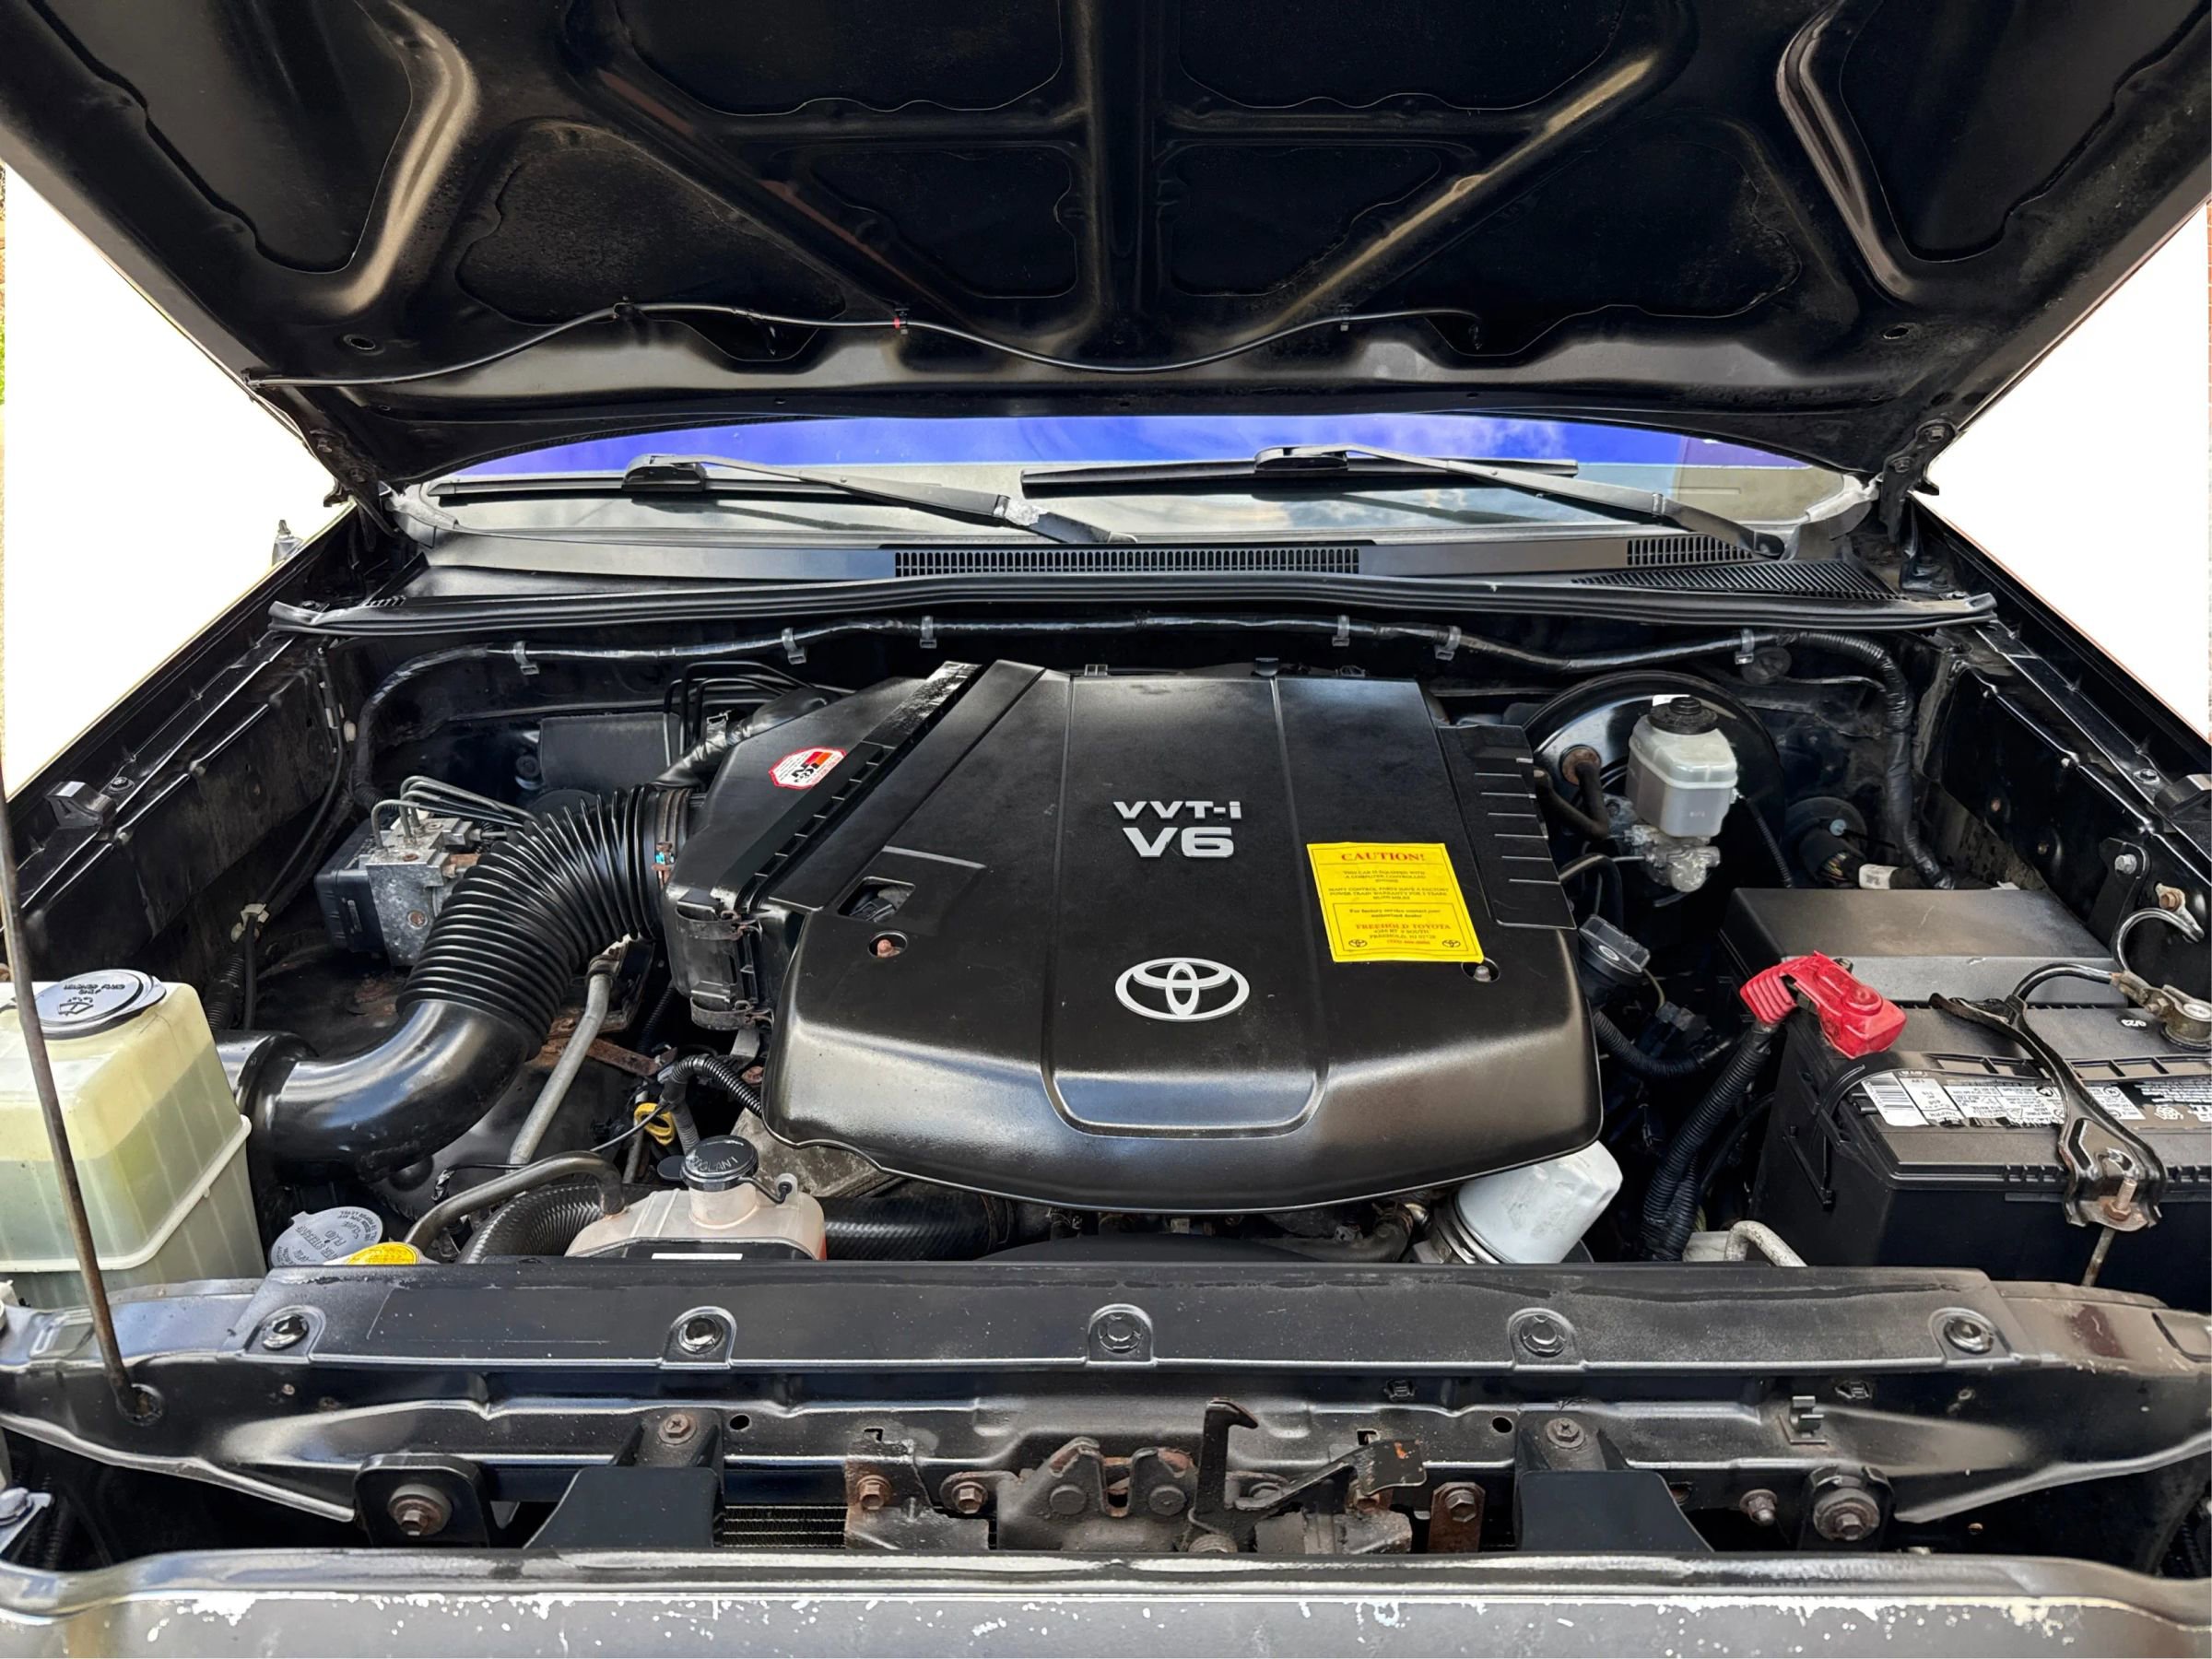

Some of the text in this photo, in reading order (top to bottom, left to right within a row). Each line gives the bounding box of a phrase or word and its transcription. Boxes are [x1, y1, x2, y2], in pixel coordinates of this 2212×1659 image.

[1113, 801, 1241, 819] VVT-i
[1123, 827, 1234, 858] V6
[1341, 852, 1426, 862] CAUTION!
[690, 1155, 738, 1172] COOLANT
[324, 1230, 347, 1247] FLUID
